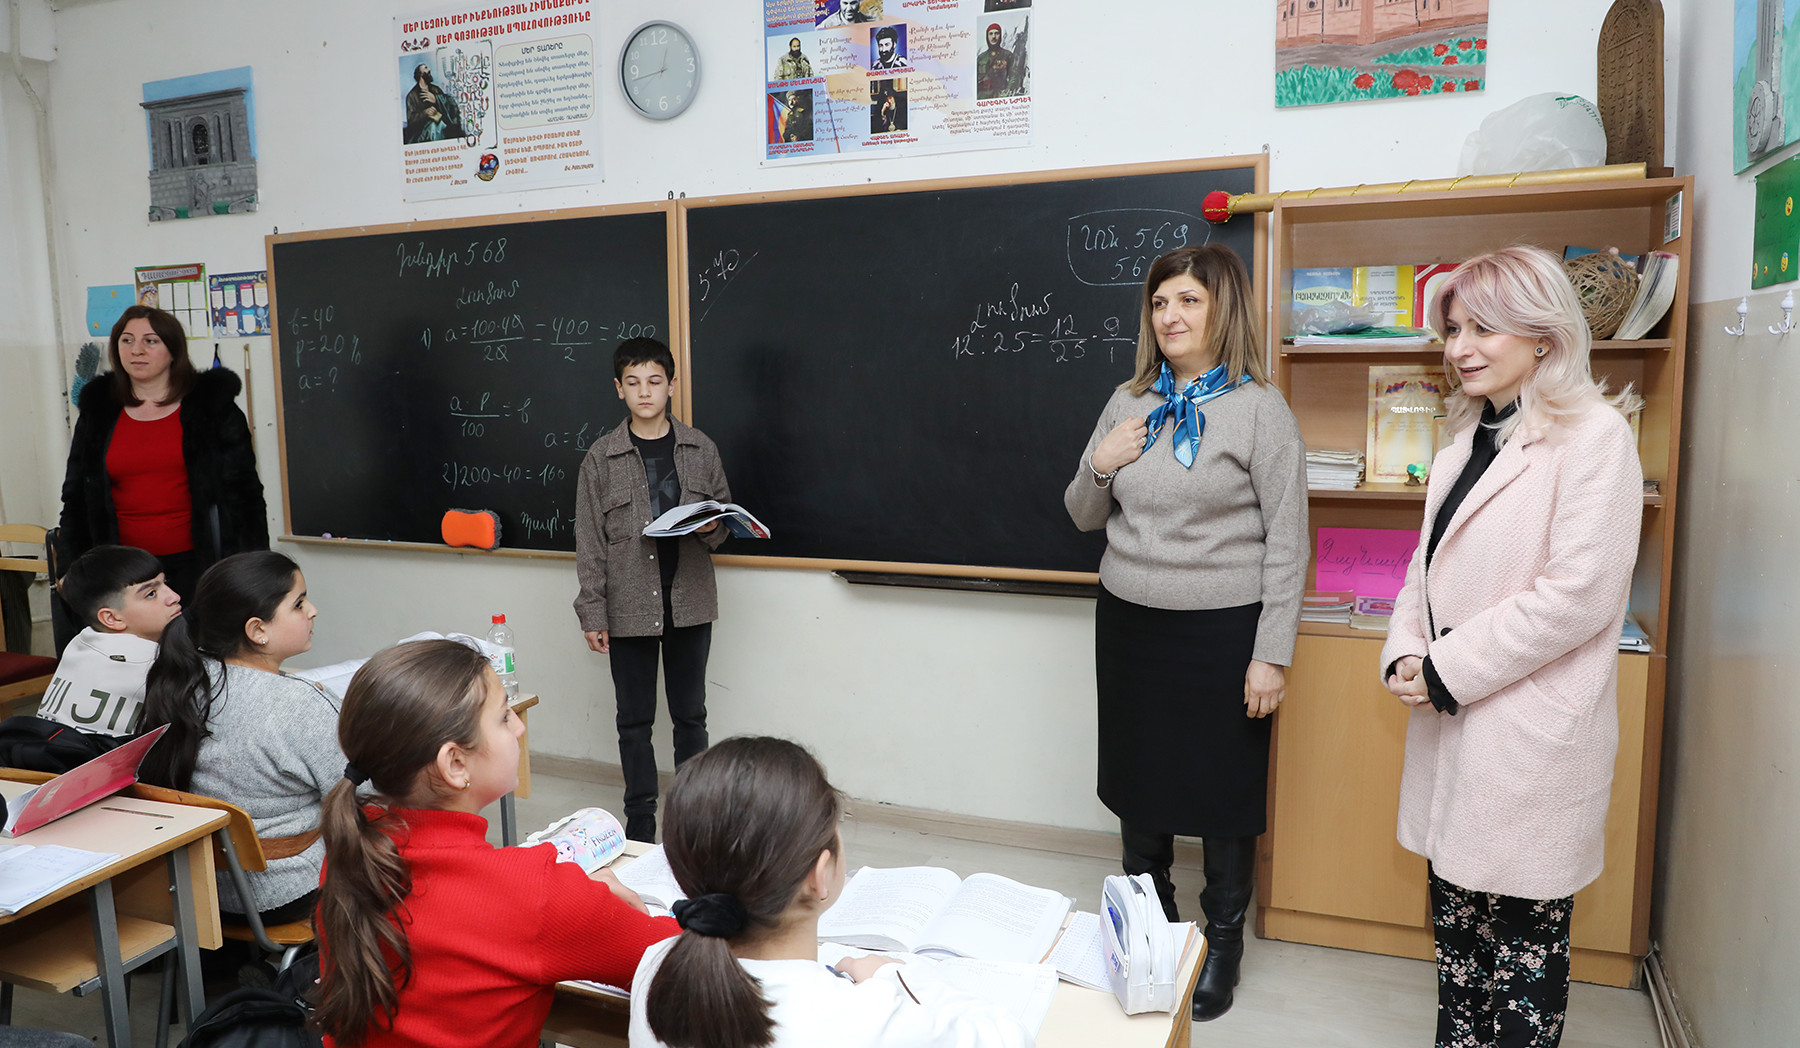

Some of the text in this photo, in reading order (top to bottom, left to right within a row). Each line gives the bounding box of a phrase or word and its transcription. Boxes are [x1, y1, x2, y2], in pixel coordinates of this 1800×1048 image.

[403, 20, 419, 34] ՄԵՐ
[420, 16, 450, 31] ԼԵԶՈՒՆ
[451, 14, 468, 26] ՄԵՐ
[469, 4, 528, 23] ԻՆՔՆՈՒԹՅԱՆ
[436, 11, 591, 45] ՄԵՐ ԳՈՅՈՒԹՅԱՆ ԱՊԱՀՈՎՈՒԹՅՈՒՆԸ
[1133, 222, 1189, 250] 569
[464, 238, 507, 267] 568
